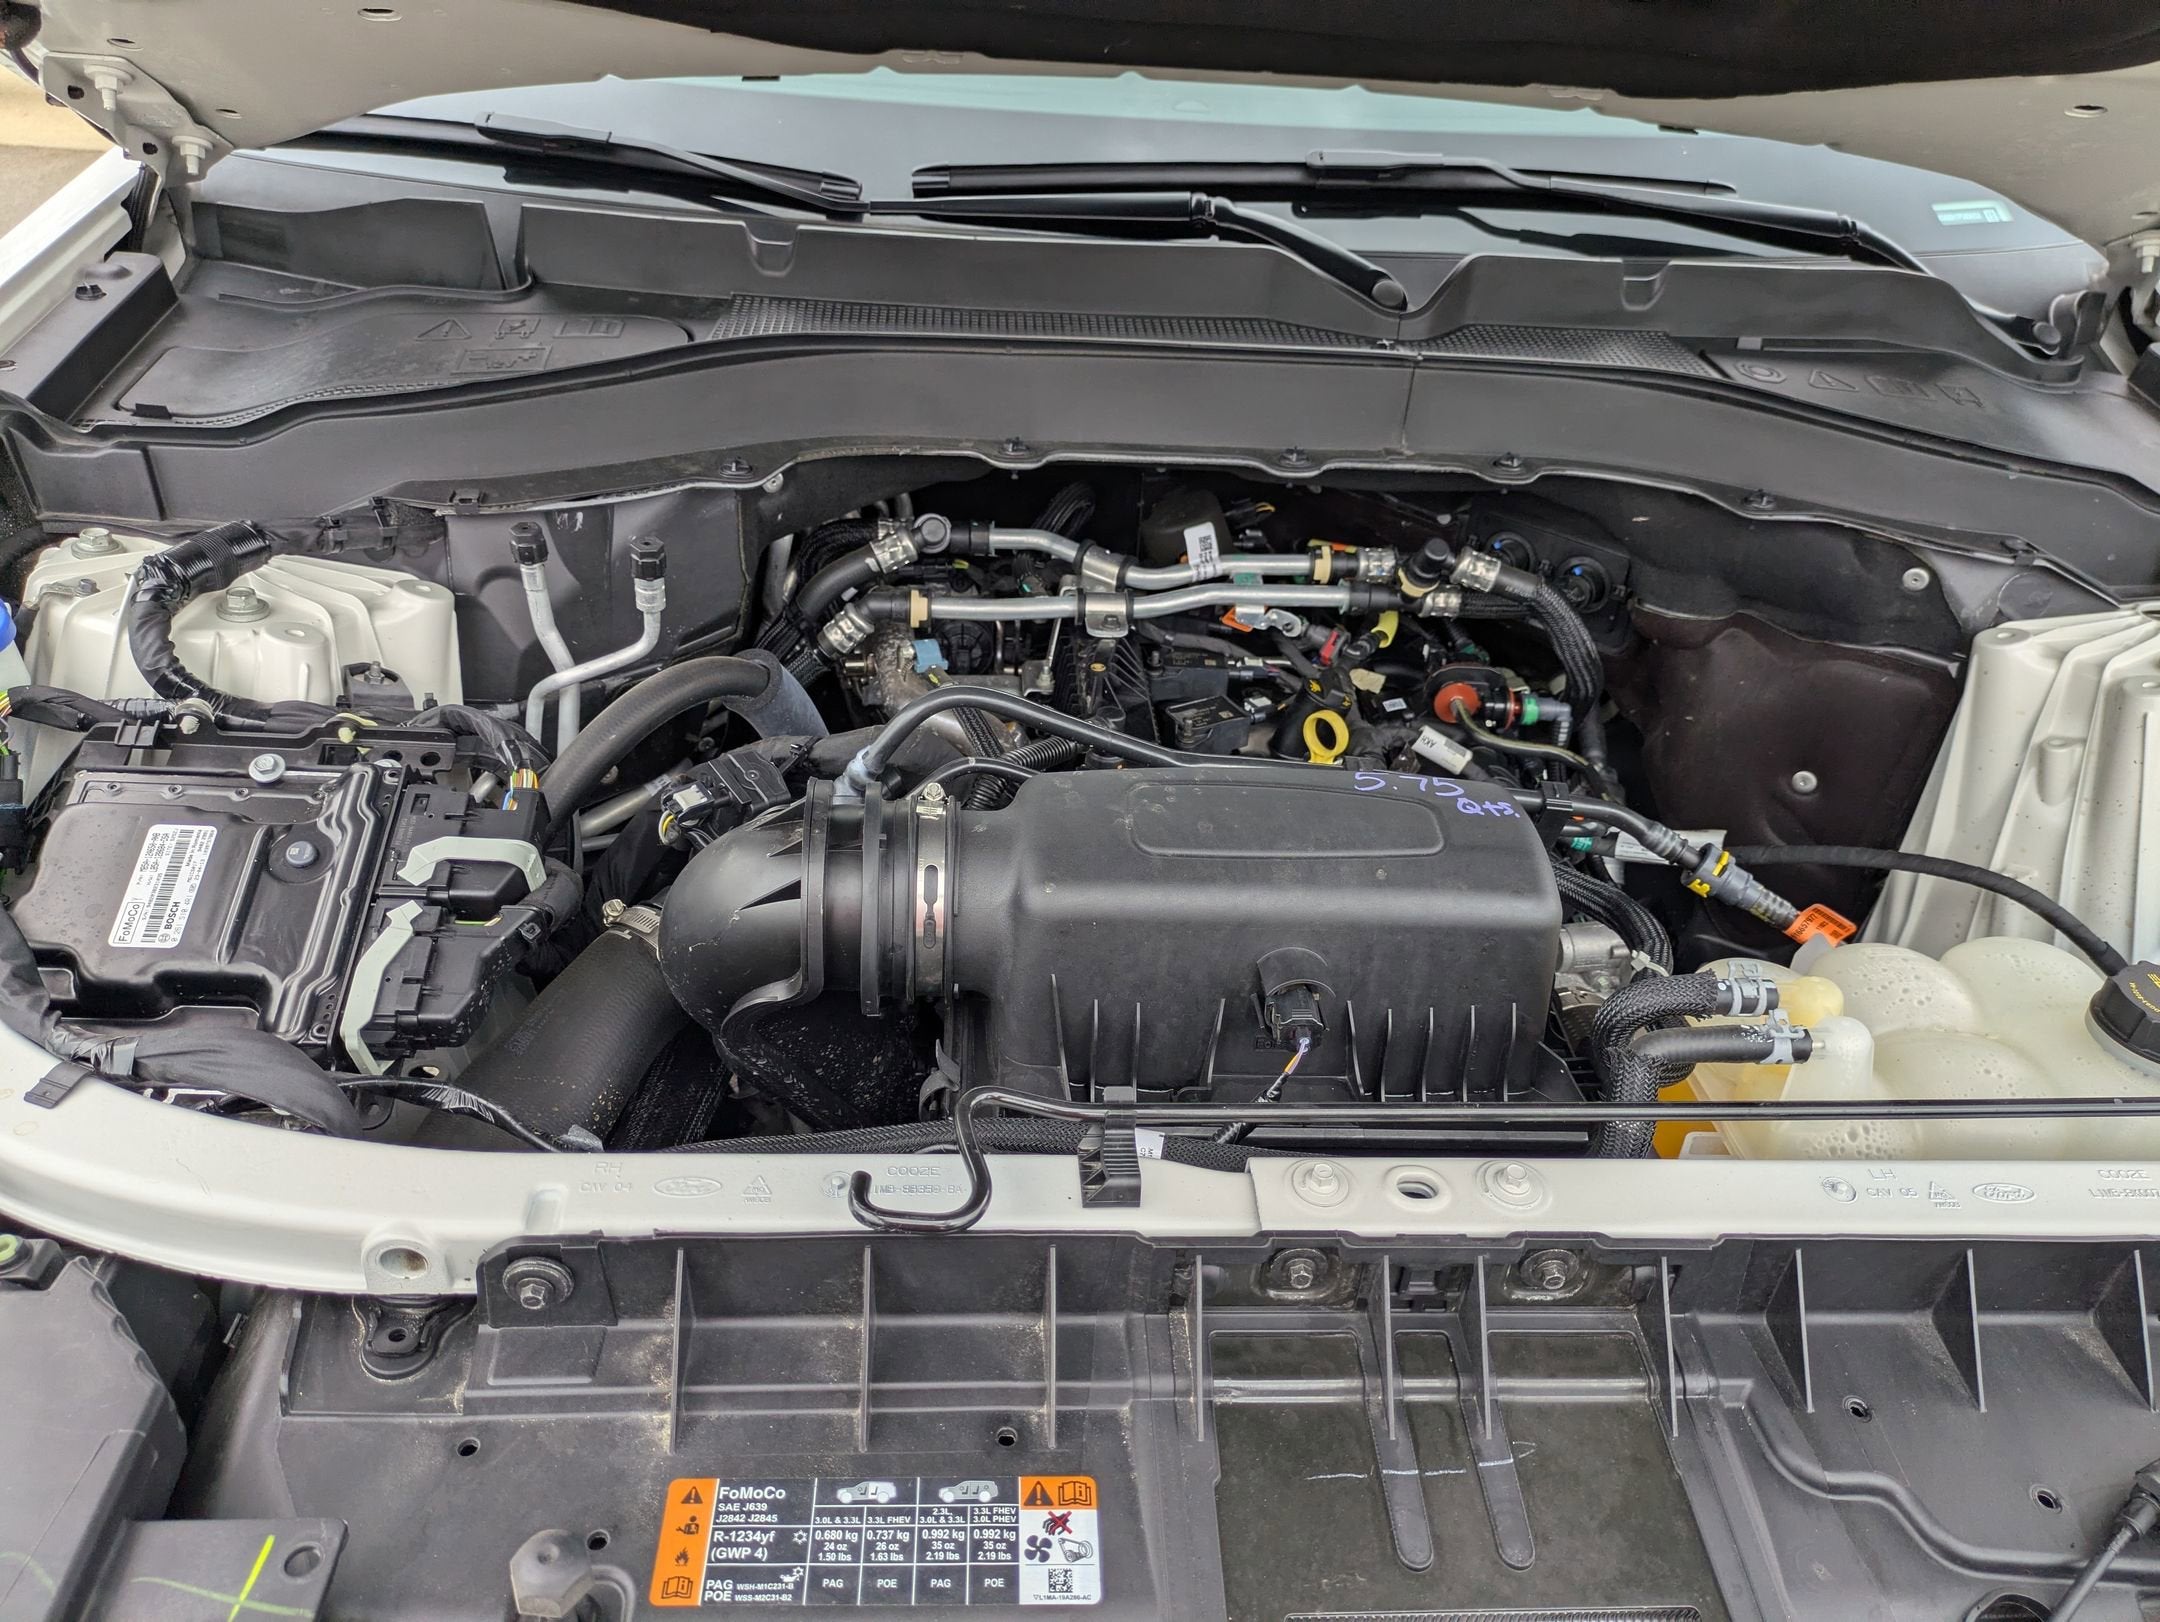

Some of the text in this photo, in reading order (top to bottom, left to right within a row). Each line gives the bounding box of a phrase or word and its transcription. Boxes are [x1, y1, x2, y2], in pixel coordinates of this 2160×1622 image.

[1354, 772, 1465, 797] 5.75
[164, 901, 181, 930] BOSCH
[118, 903, 140, 942] FoMoCo
[594, 1161, 622, 1174] RH
[718, 1486, 786, 1500] FoMoCo
[718, 1503, 768, 1511] SAE J639
[974, 1507, 1016, 1515] 3.3L FHEV
[716, 1514, 778, 1523] J2842 J2845
[814, 1516, 861, 1524] 3.0L & 3.3L
[867, 1516, 911, 1524] 3.3L FHEV
[919, 1515, 965, 1524] 3.0L & 3.3L
[973, 1515, 1016, 1523] 3.0L PHEV
[713, 1530, 776, 1544] R-1234yf
[815, 1530, 858, 1543] 0.680 kg
[867, 1530, 910, 1542] 0.737 kg
[922, 1529, 965, 1542] 0.992 kg
[973, 1529, 1016, 1542] 0.992 kg
[823, 1542, 848, 1551] 24 oz
[875, 1542, 900, 1551] 26 oz
[931, 1541, 943, 1550] 35
[983, 1541, 1007, 1550] 35 oz
[711, 1547, 768, 1562] (GWP 4)
[818, 1552, 852, 1561] 1.50 lbs
[870, 1552, 904, 1561] 1.63 lbs
[925, 1552, 960, 1560] 2.19 lbs
[977, 1551, 1012, 1560] 2.19 lbs
[706, 1579, 733, 1590] PAG
[822, 1579, 844, 1588] PAG
[876, 1579, 898, 1588] POE
[930, 1579, 951, 1588] PAG
[984, 1578, 1005, 1587] POE
[704, 1590, 732, 1601] POE
